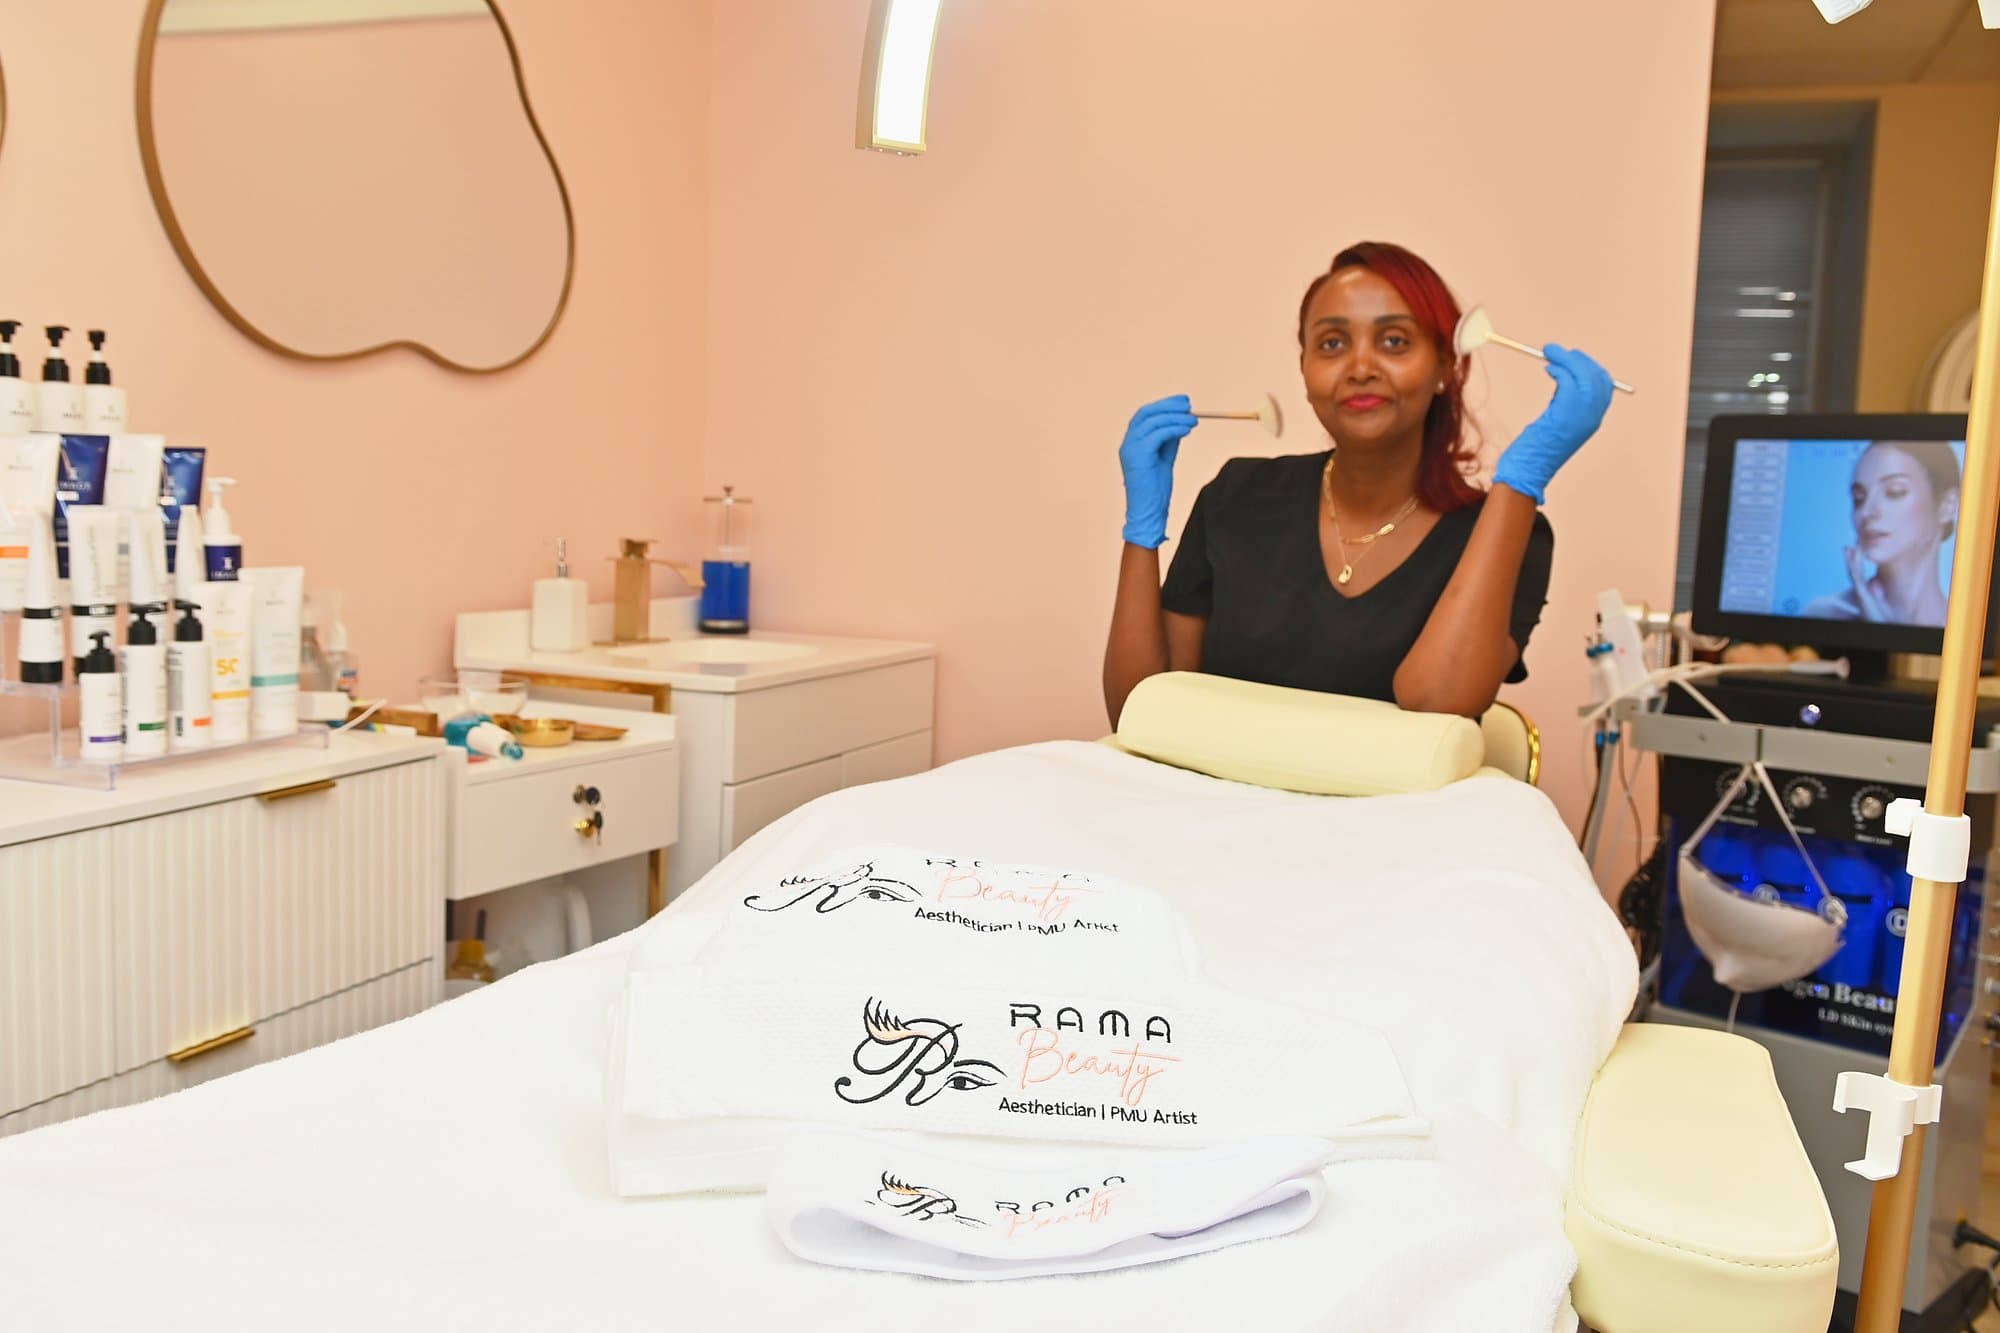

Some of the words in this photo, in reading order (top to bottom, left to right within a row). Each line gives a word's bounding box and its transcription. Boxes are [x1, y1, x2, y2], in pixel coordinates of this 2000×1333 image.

[914, 906, 1013, 933] Aesthetician
[1009, 1003, 1172, 1044] RAMA
[1018, 1027, 1183, 1107] Beauty
[998, 1097, 1097, 1119] Aesthetician
[1110, 1105, 1148, 1123] PMU
[1153, 1109, 1199, 1126] Artist
